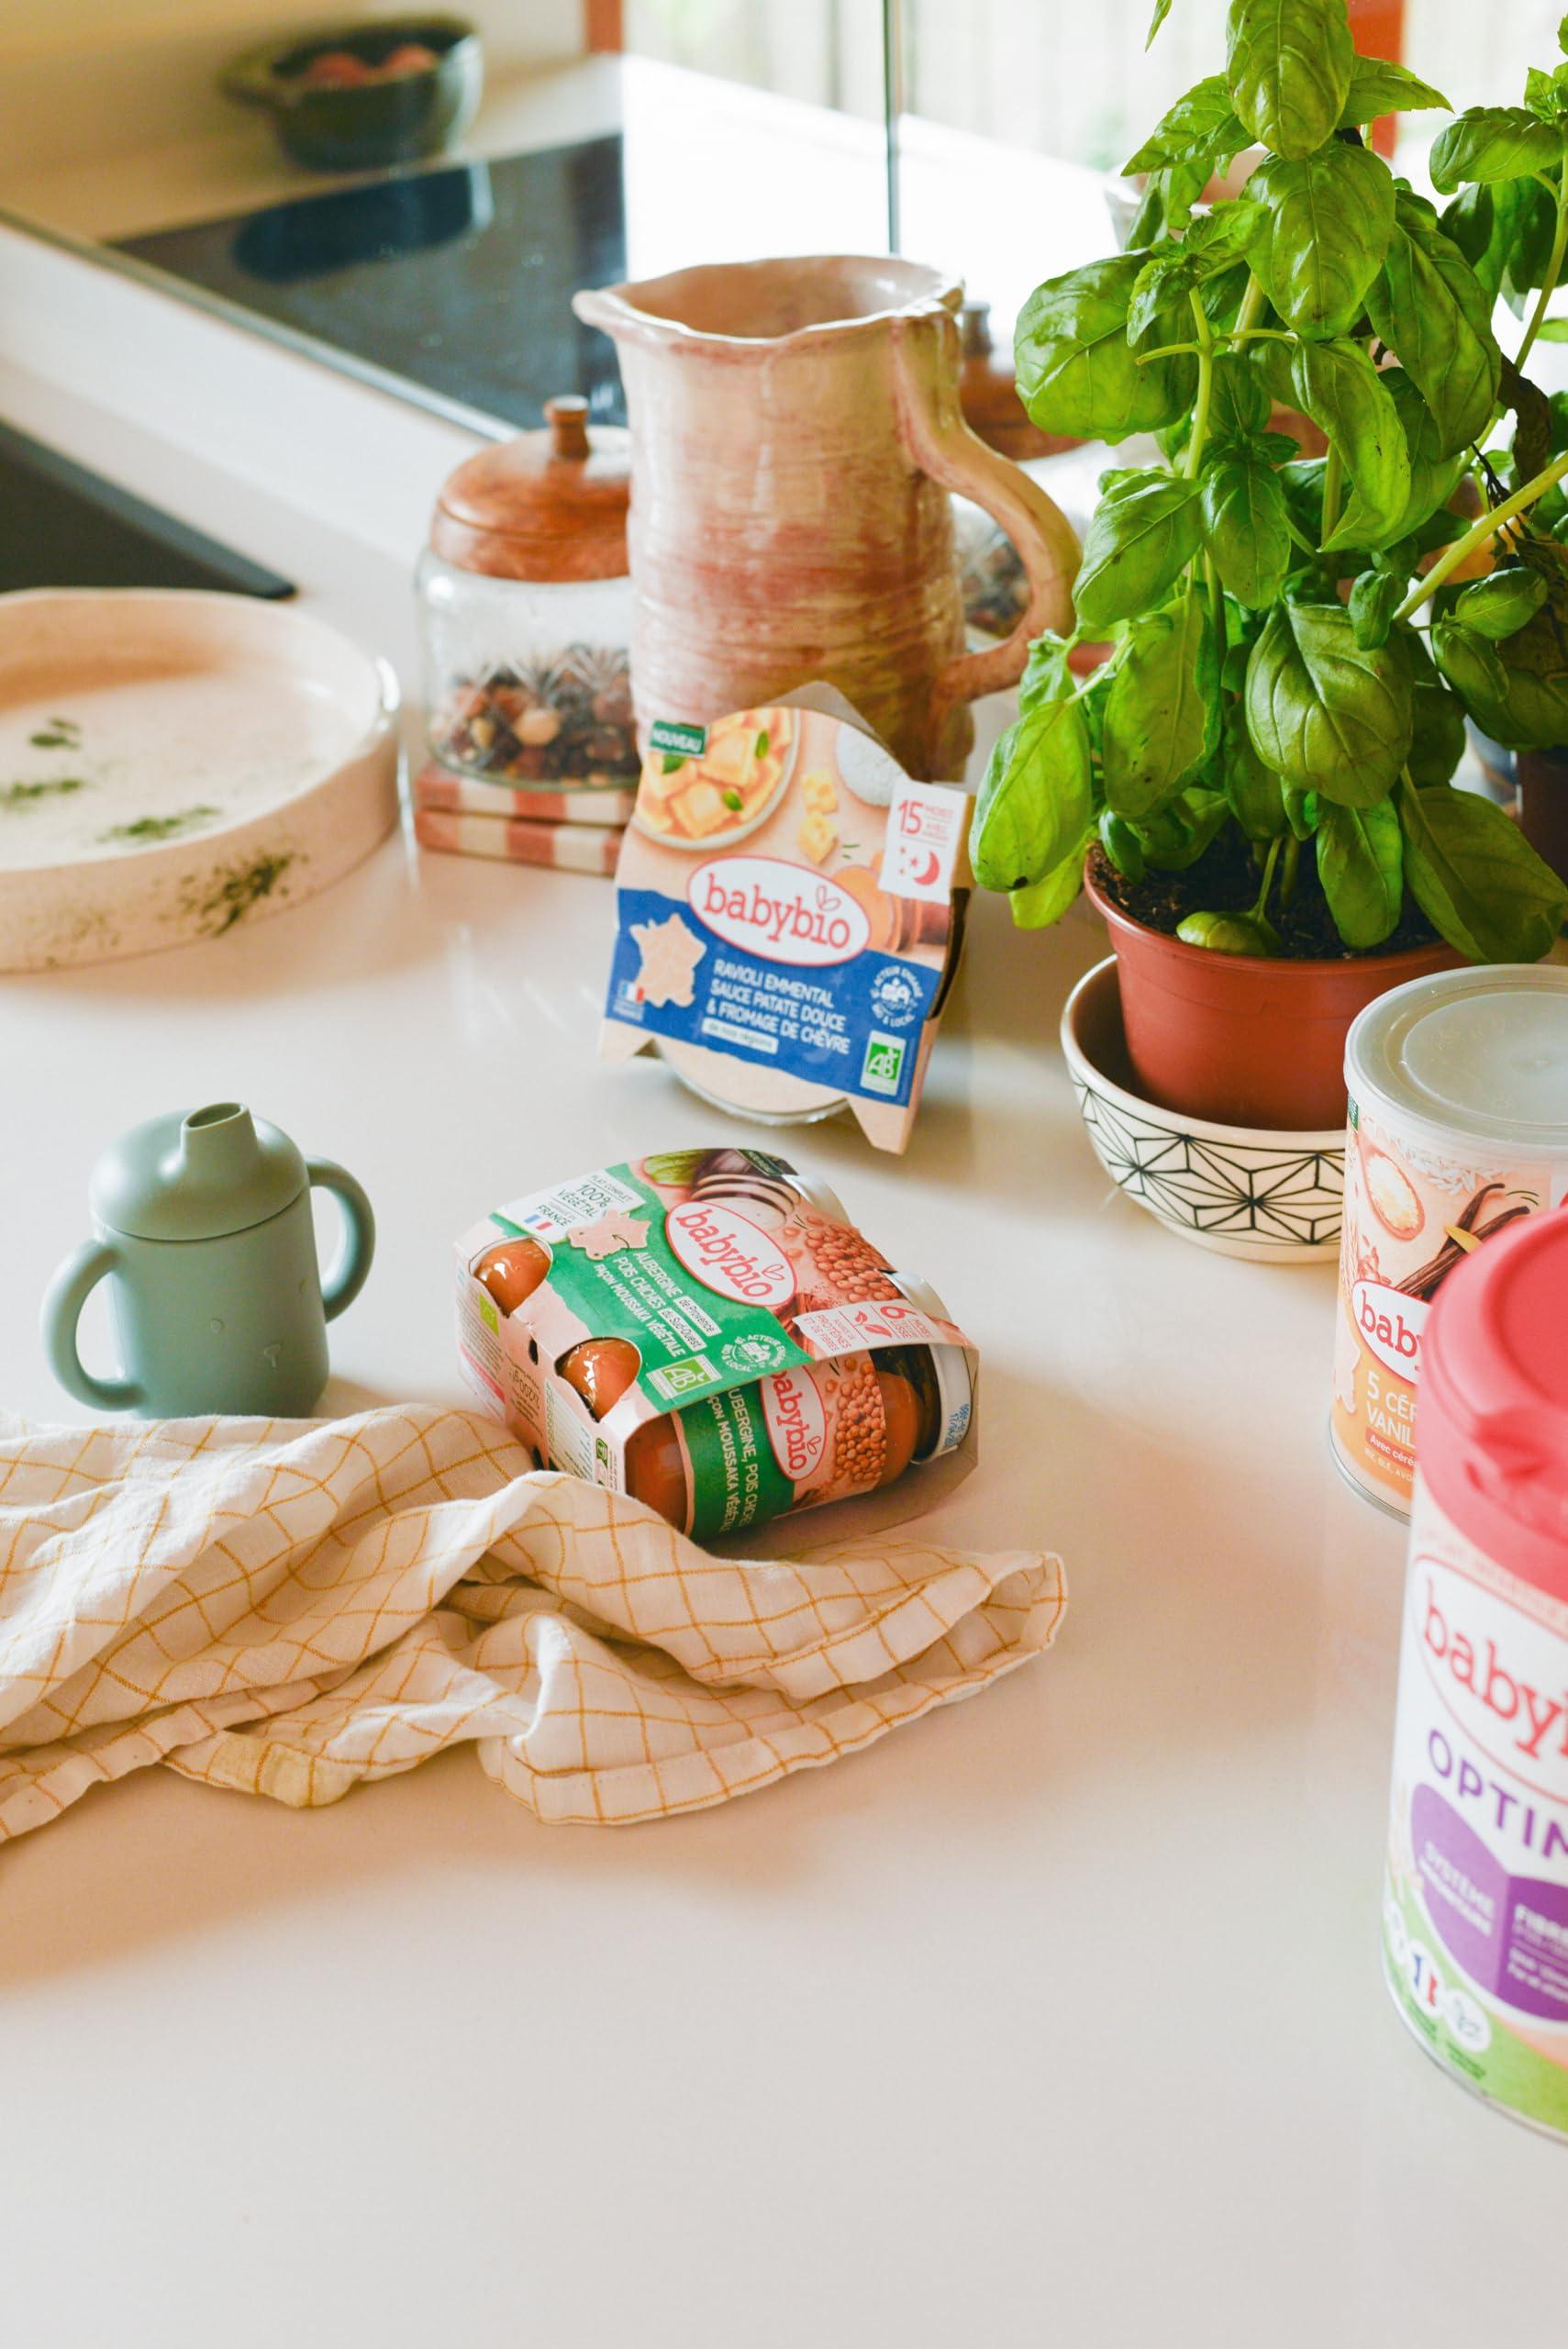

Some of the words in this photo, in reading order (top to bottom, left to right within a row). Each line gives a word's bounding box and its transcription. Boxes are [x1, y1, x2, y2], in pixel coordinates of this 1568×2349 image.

[652, 729, 702, 751] NOUVEAU
[898, 799, 925, 835] 15
[704, 872, 851, 949] babybio
[714, 959, 764, 986] RAVIOLI
[763, 973, 834, 1008] EMMENTAL
[707, 996, 717, 1015] &
[718, 1001, 780, 1033] FROMAGE
[781, 1019, 799, 1039] DE
[710, 978, 752, 1004] SAUCE
[752, 990, 800, 1018] PATATE
[800, 1006, 847, 1032] DOUCE
[576, 1184, 612, 1208] 100%
[536, 1205, 573, 1227] FRANCE
[675, 1208, 773, 1297] babybio
[613, 1256, 639, 1277] POIS
[630, 1276, 666, 1309] CHICHES
[633, 1252, 683, 1297] AUBERGINE
[610, 1283, 652, 1322] MOUSSAKA
[880, 1306, 917, 1319] 6
[747, 1334, 781, 1346] ACTEUR
[664, 1367, 697, 1388] AB
[1366, 1370, 1380, 1400] 5
[717, 1420, 739, 1492] MOUSSAKA
[1370, 1434, 1391, 1455] Avec
[745, 1464, 758, 1492] POIS
